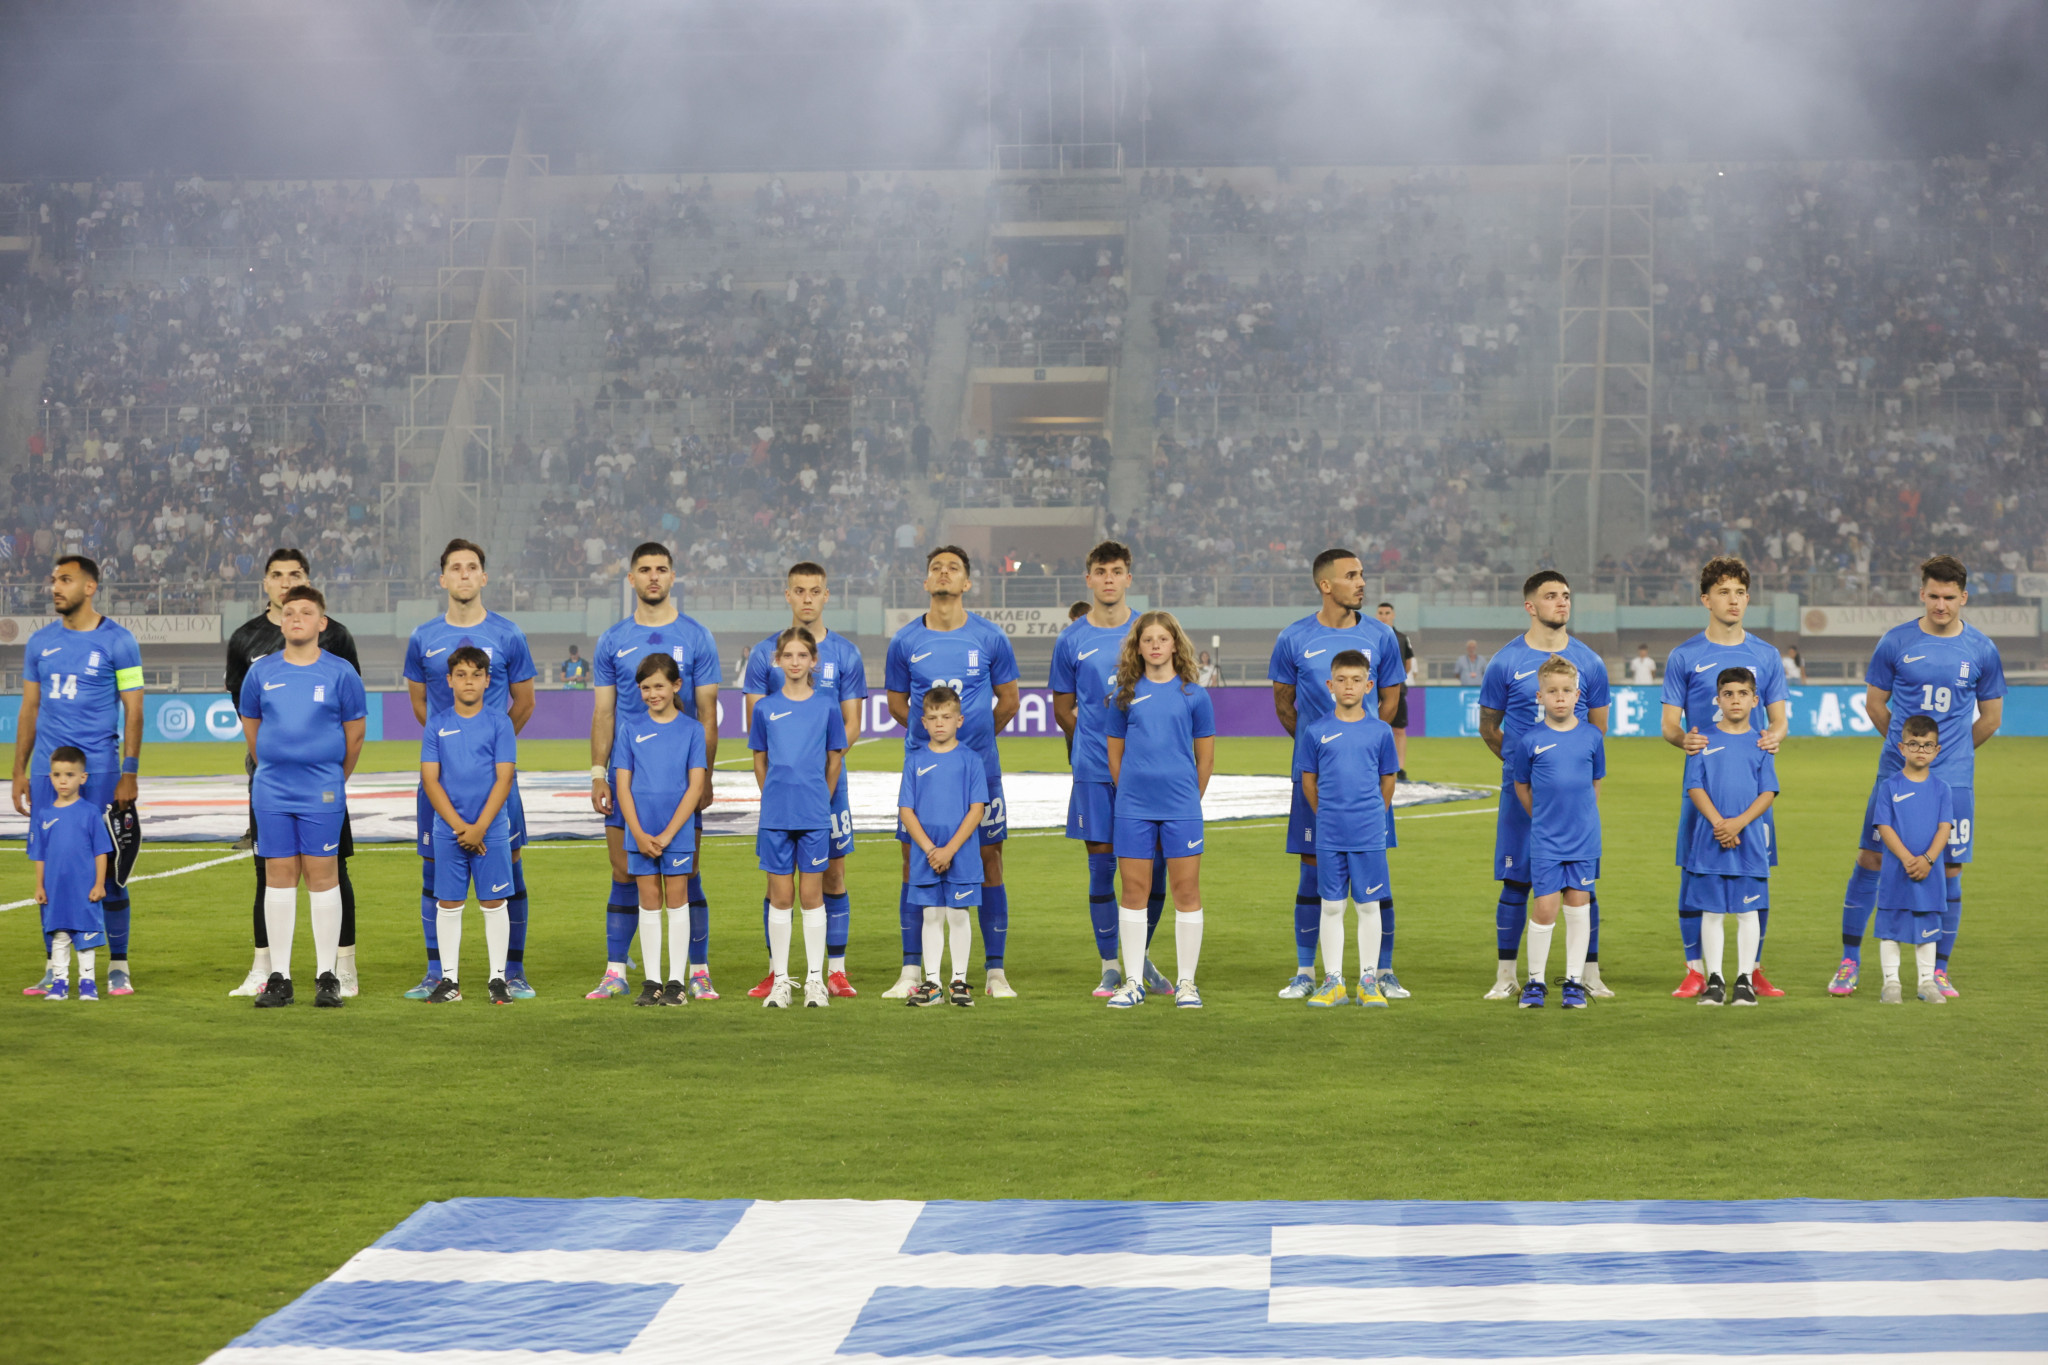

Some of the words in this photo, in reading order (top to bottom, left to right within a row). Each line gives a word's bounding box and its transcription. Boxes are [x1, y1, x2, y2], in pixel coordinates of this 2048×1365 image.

[49, 673, 77, 699] 14
[1920, 684, 1951, 713] 19
[830, 809, 852, 840] 18
[980, 797, 1005, 827] 22
[1948, 818, 1971, 845] 19
